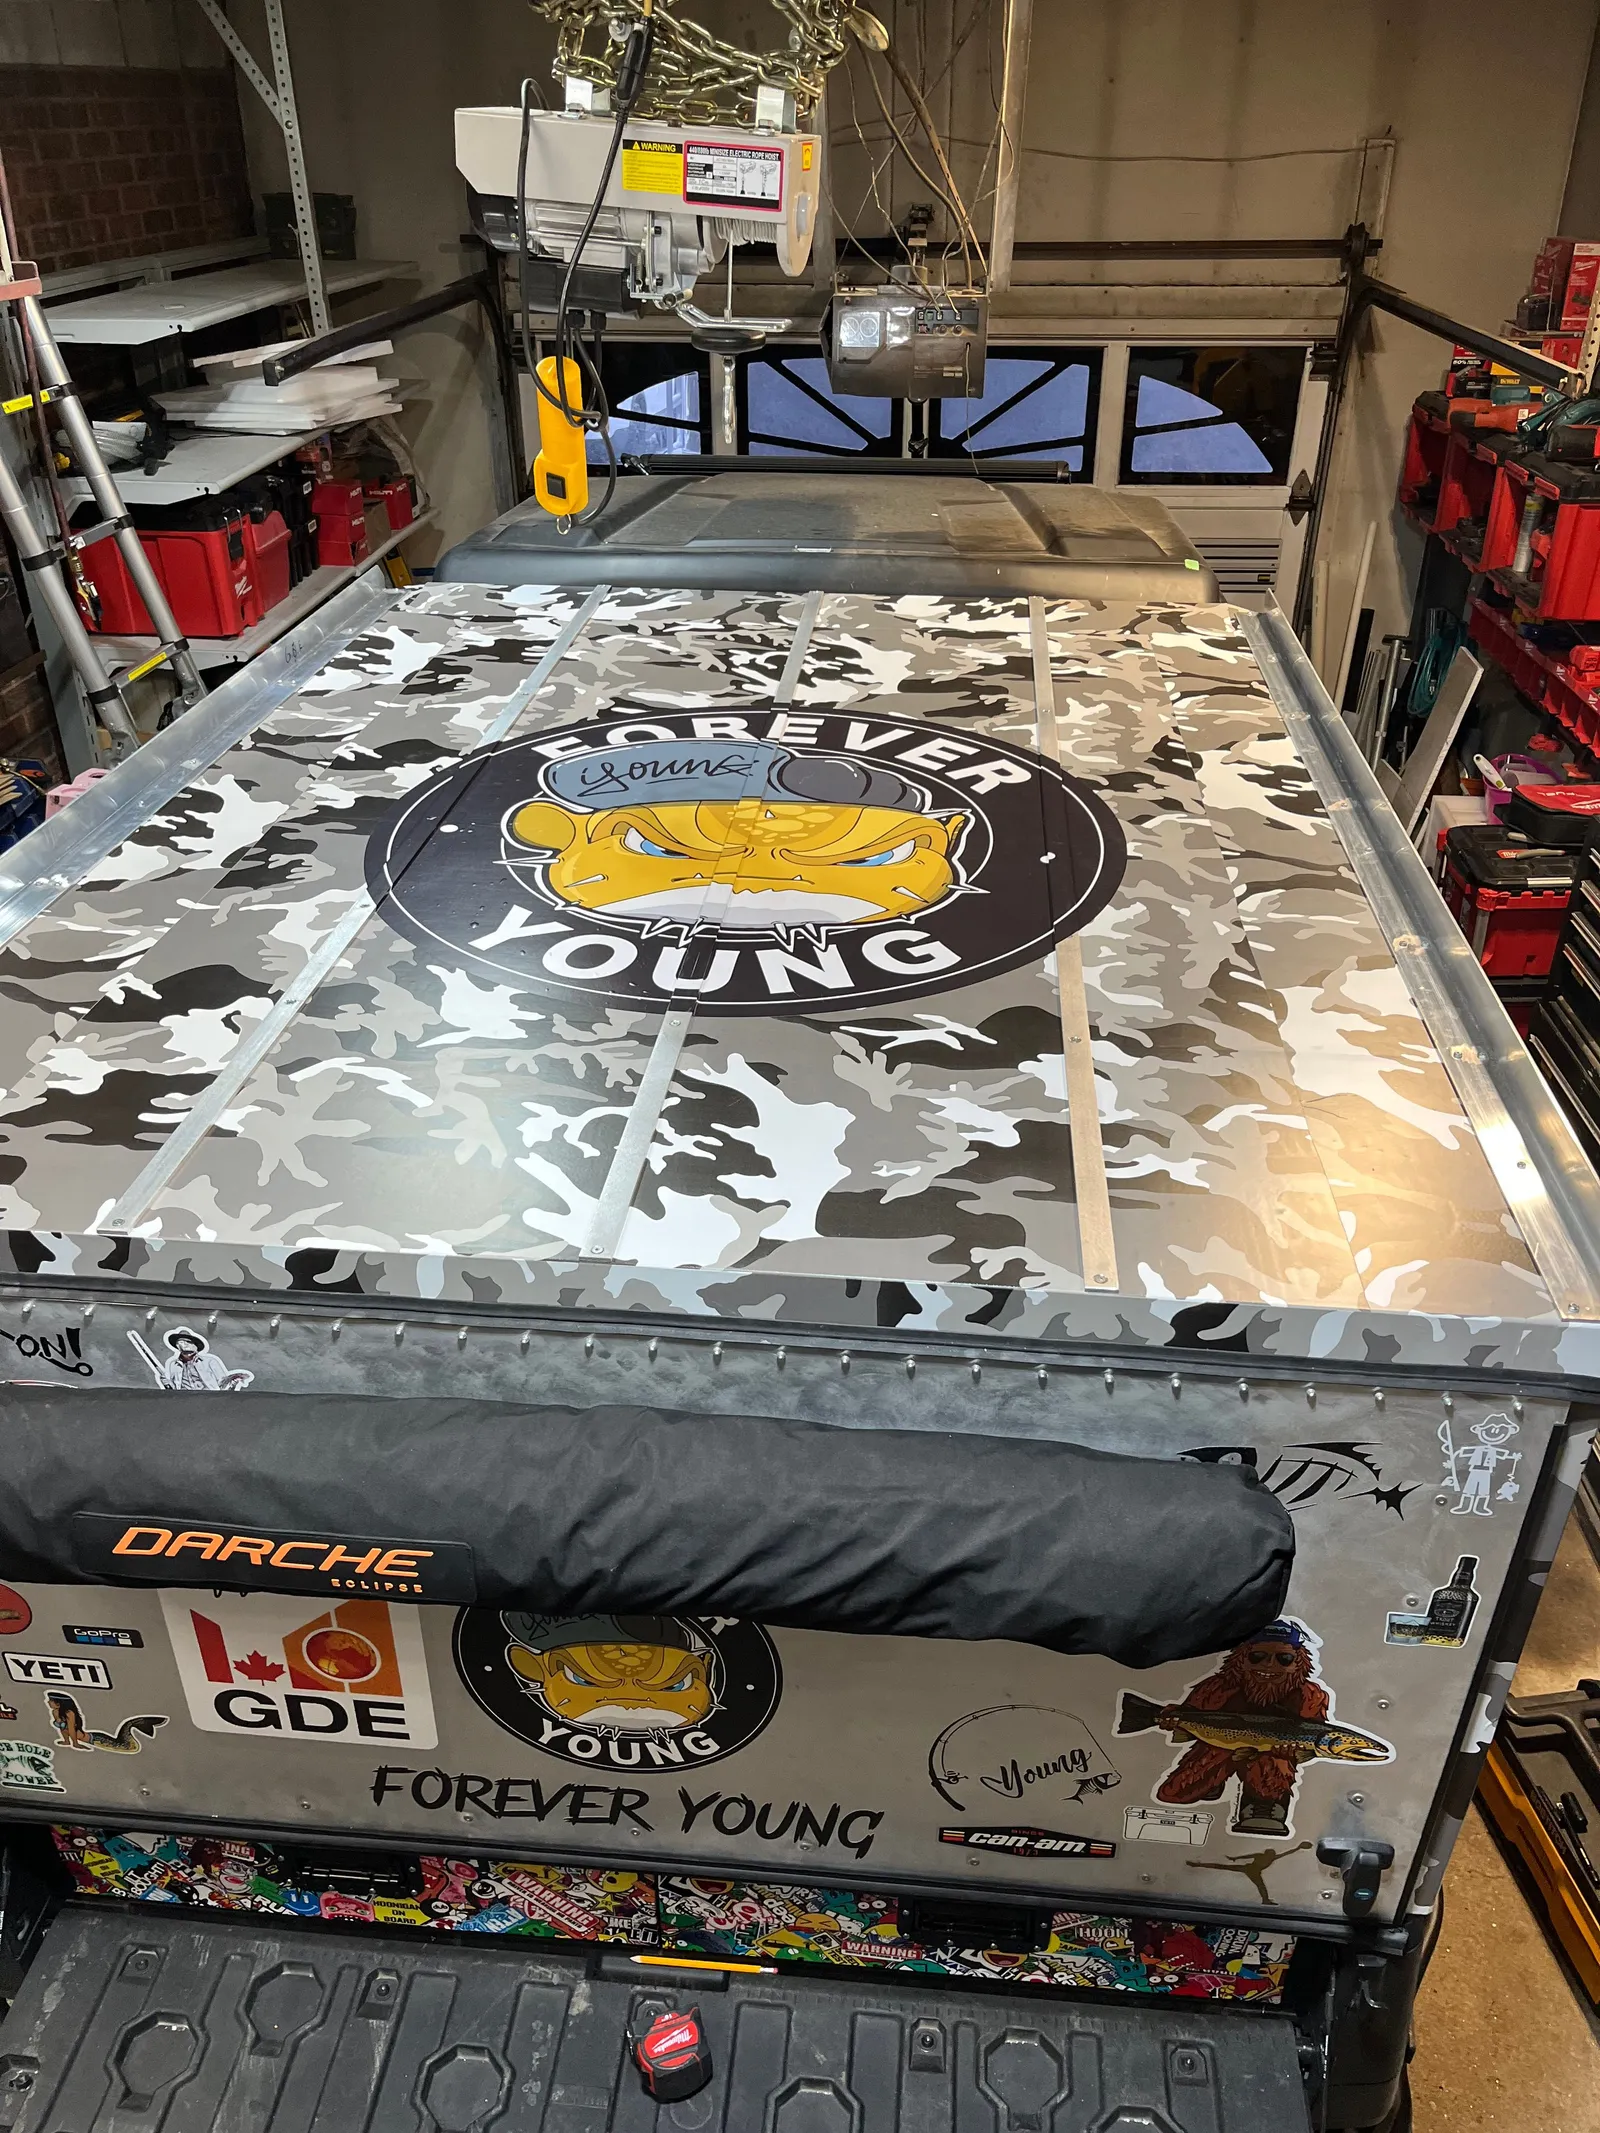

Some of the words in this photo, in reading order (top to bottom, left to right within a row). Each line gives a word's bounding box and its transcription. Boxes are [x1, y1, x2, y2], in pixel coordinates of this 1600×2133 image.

[640, 141, 676, 152] WARNING
[729, 149, 752, 158] ELECTRIC
[752, 151, 764, 160] ROPE
[532, 715, 1032, 795] FOREVER
[468, 904, 962, 996] YOUNG
[111, 1526, 434, 1578] DARCHE
[331, 1578, 423, 1593] ECLIPSE
[73, 1628, 131, 1639] GoPro
[10, 1658, 101, 1684] YETI
[213, 1688, 411, 1741] GDE
[15, 1743, 51, 1758] HOLE
[537, 1718, 721, 1766] YOUNG
[3, 1771, 58, 1785] POWER
[979, 1748, 1092, 1799] Young
[368, 1764, 654, 1833] FOREVER
[677, 1785, 885, 1860] YOUNG
[968, 1832, 1087, 1853] can-am
[373, 1900, 421, 1911] HOONIGAN
[514, 1873, 594, 1925] WARNING
[384, 1916, 417, 1925] BOARD
[392, 1909, 406, 1917] ON
[846, 1941, 918, 1958] WARNING
